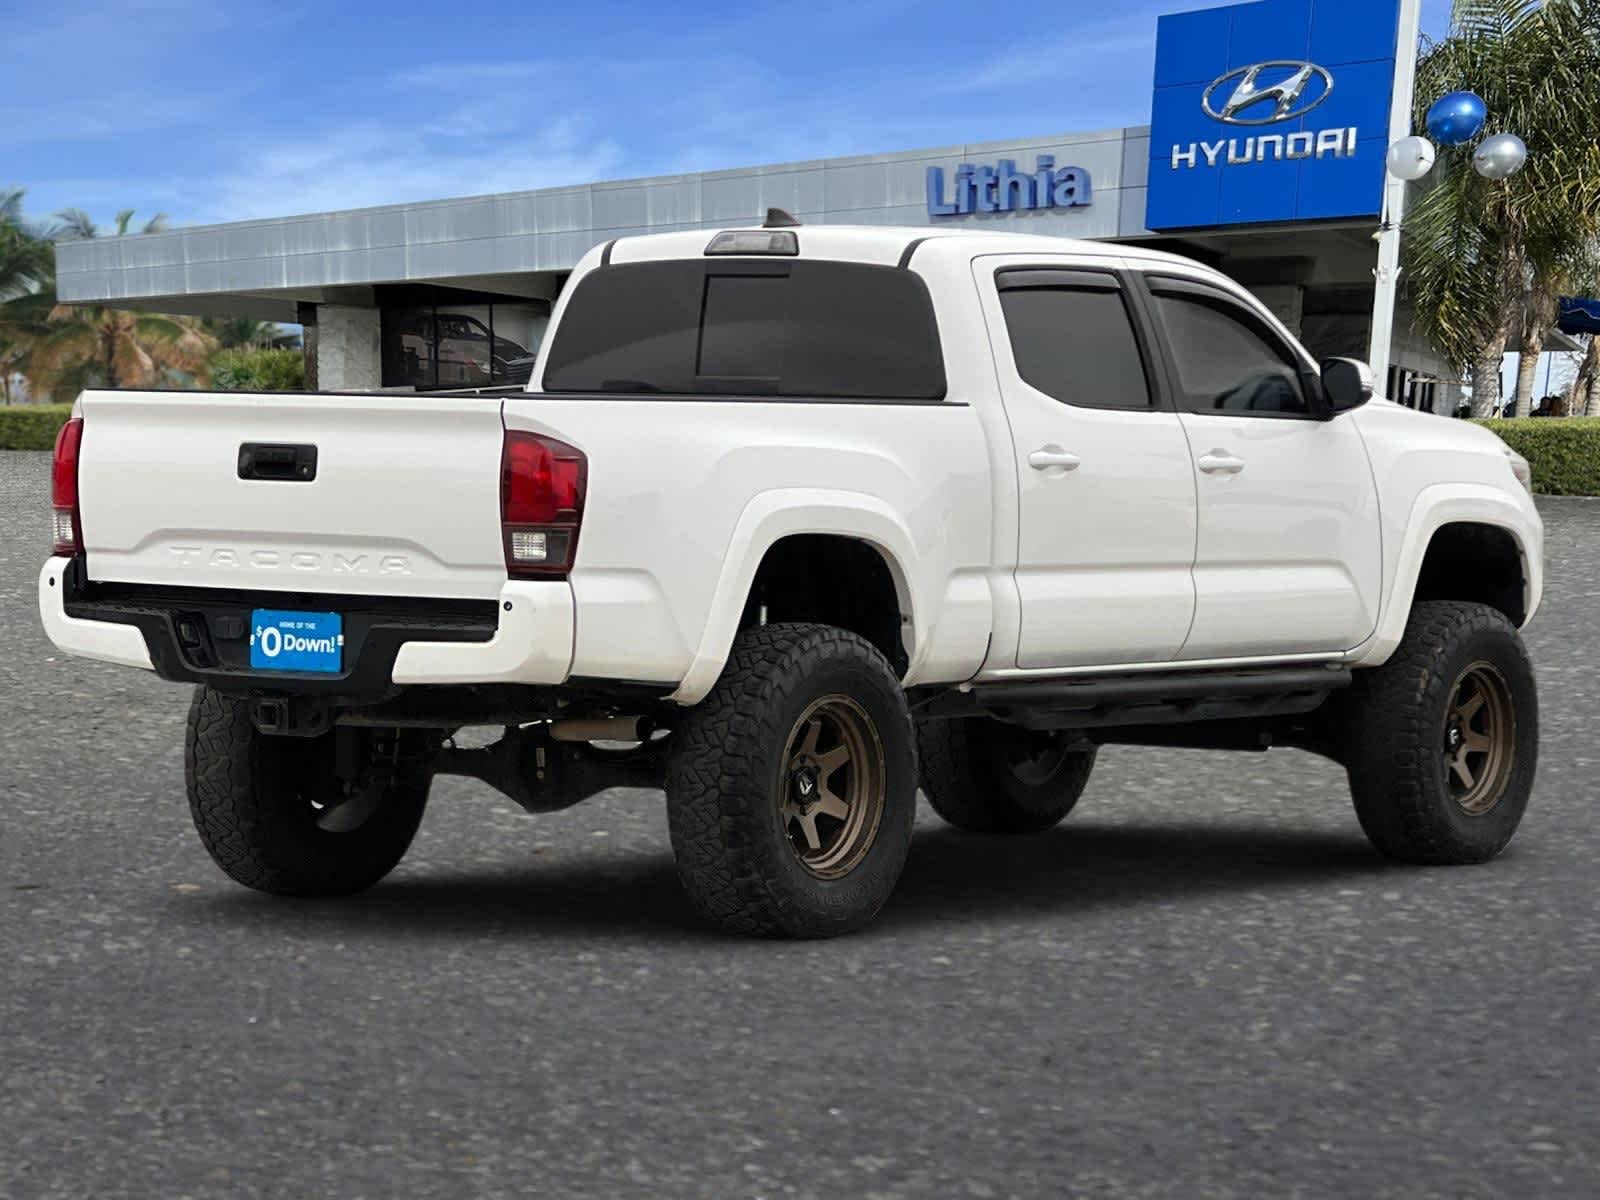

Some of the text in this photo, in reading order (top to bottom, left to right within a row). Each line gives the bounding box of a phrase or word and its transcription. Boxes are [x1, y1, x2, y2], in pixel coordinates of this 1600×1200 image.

[1171, 127, 1357, 169] HYUNDAI
[926, 154, 1092, 216] Lithia
[168, 546, 413, 575] TACOMA
[283, 634, 335, 654] Down!
